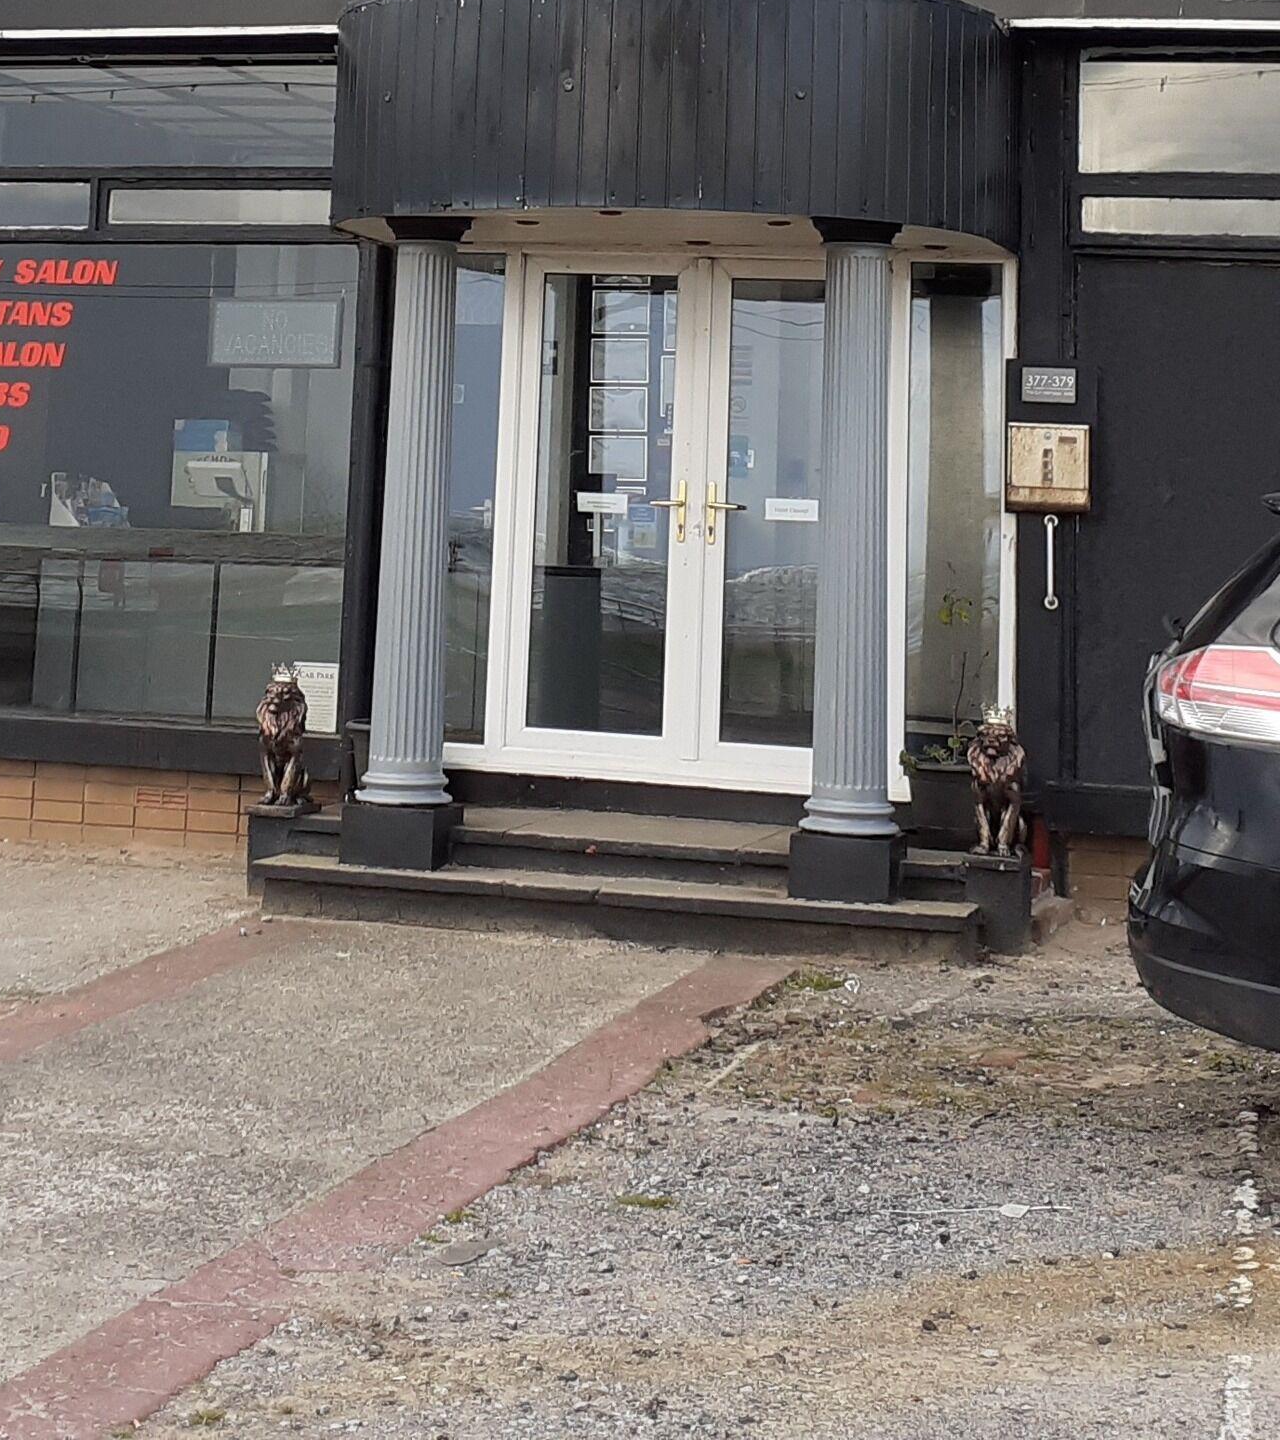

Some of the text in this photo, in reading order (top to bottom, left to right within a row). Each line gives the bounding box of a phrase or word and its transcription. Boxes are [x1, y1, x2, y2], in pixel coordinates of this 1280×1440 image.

[14, 260, 118, 285] SALON
[1026, 375, 1074, 388] 377-379
[317, 672, 335, 680] PARK
